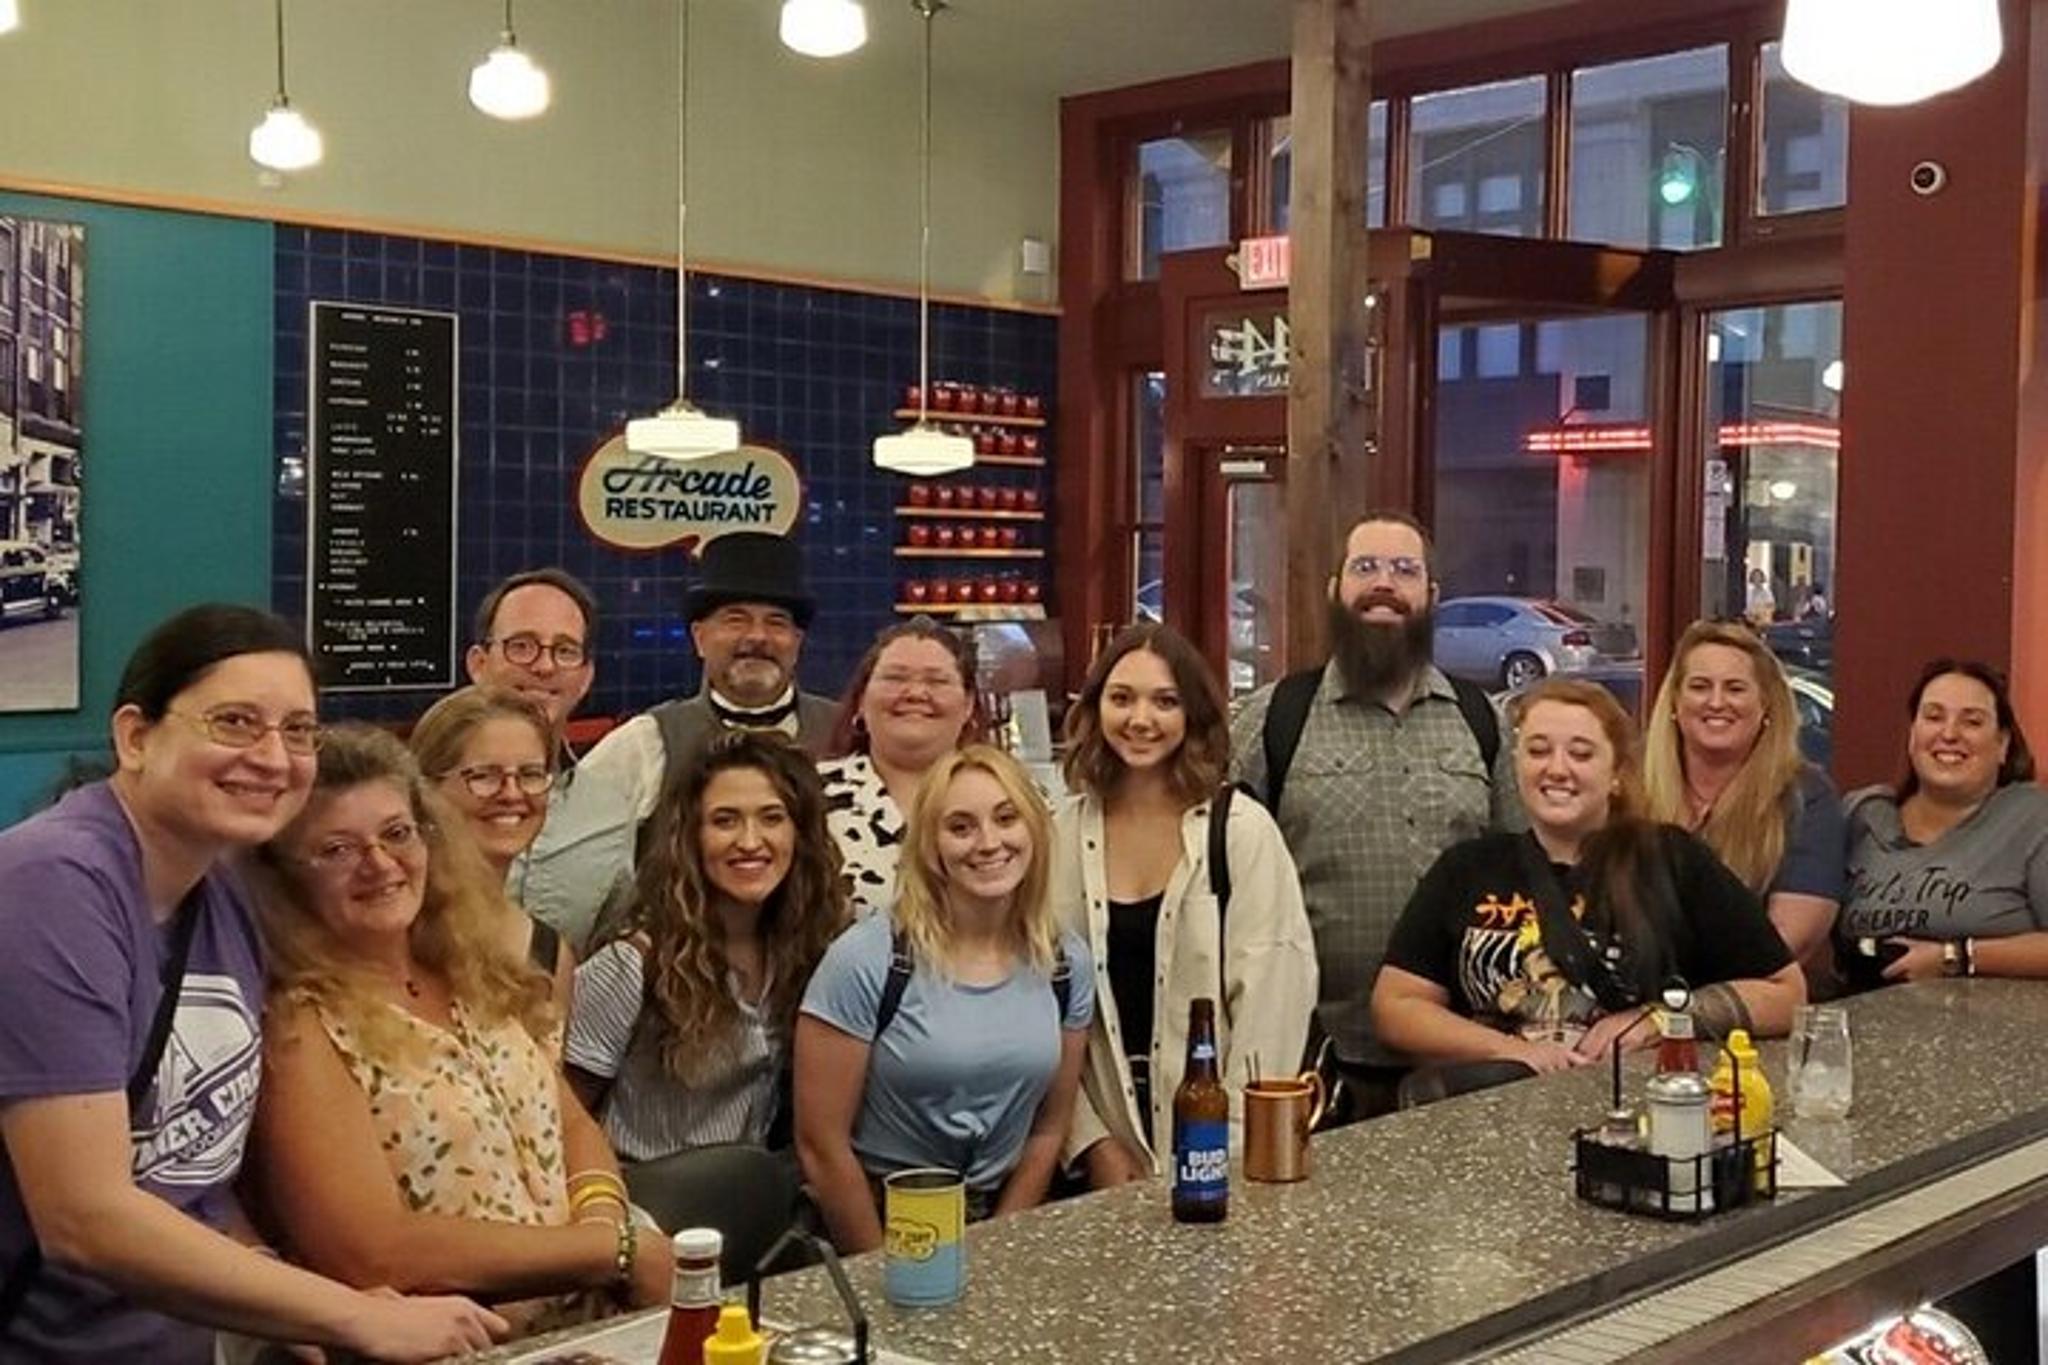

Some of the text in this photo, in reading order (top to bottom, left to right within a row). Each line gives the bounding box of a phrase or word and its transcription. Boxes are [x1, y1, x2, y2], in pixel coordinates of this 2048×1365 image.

[602, 457, 772, 501] Arcade
[605, 497, 777, 523] RESTAURANT
[1849, 908, 1930, 931] CHEAPER
[1188, 1148, 1227, 1169] BUD
